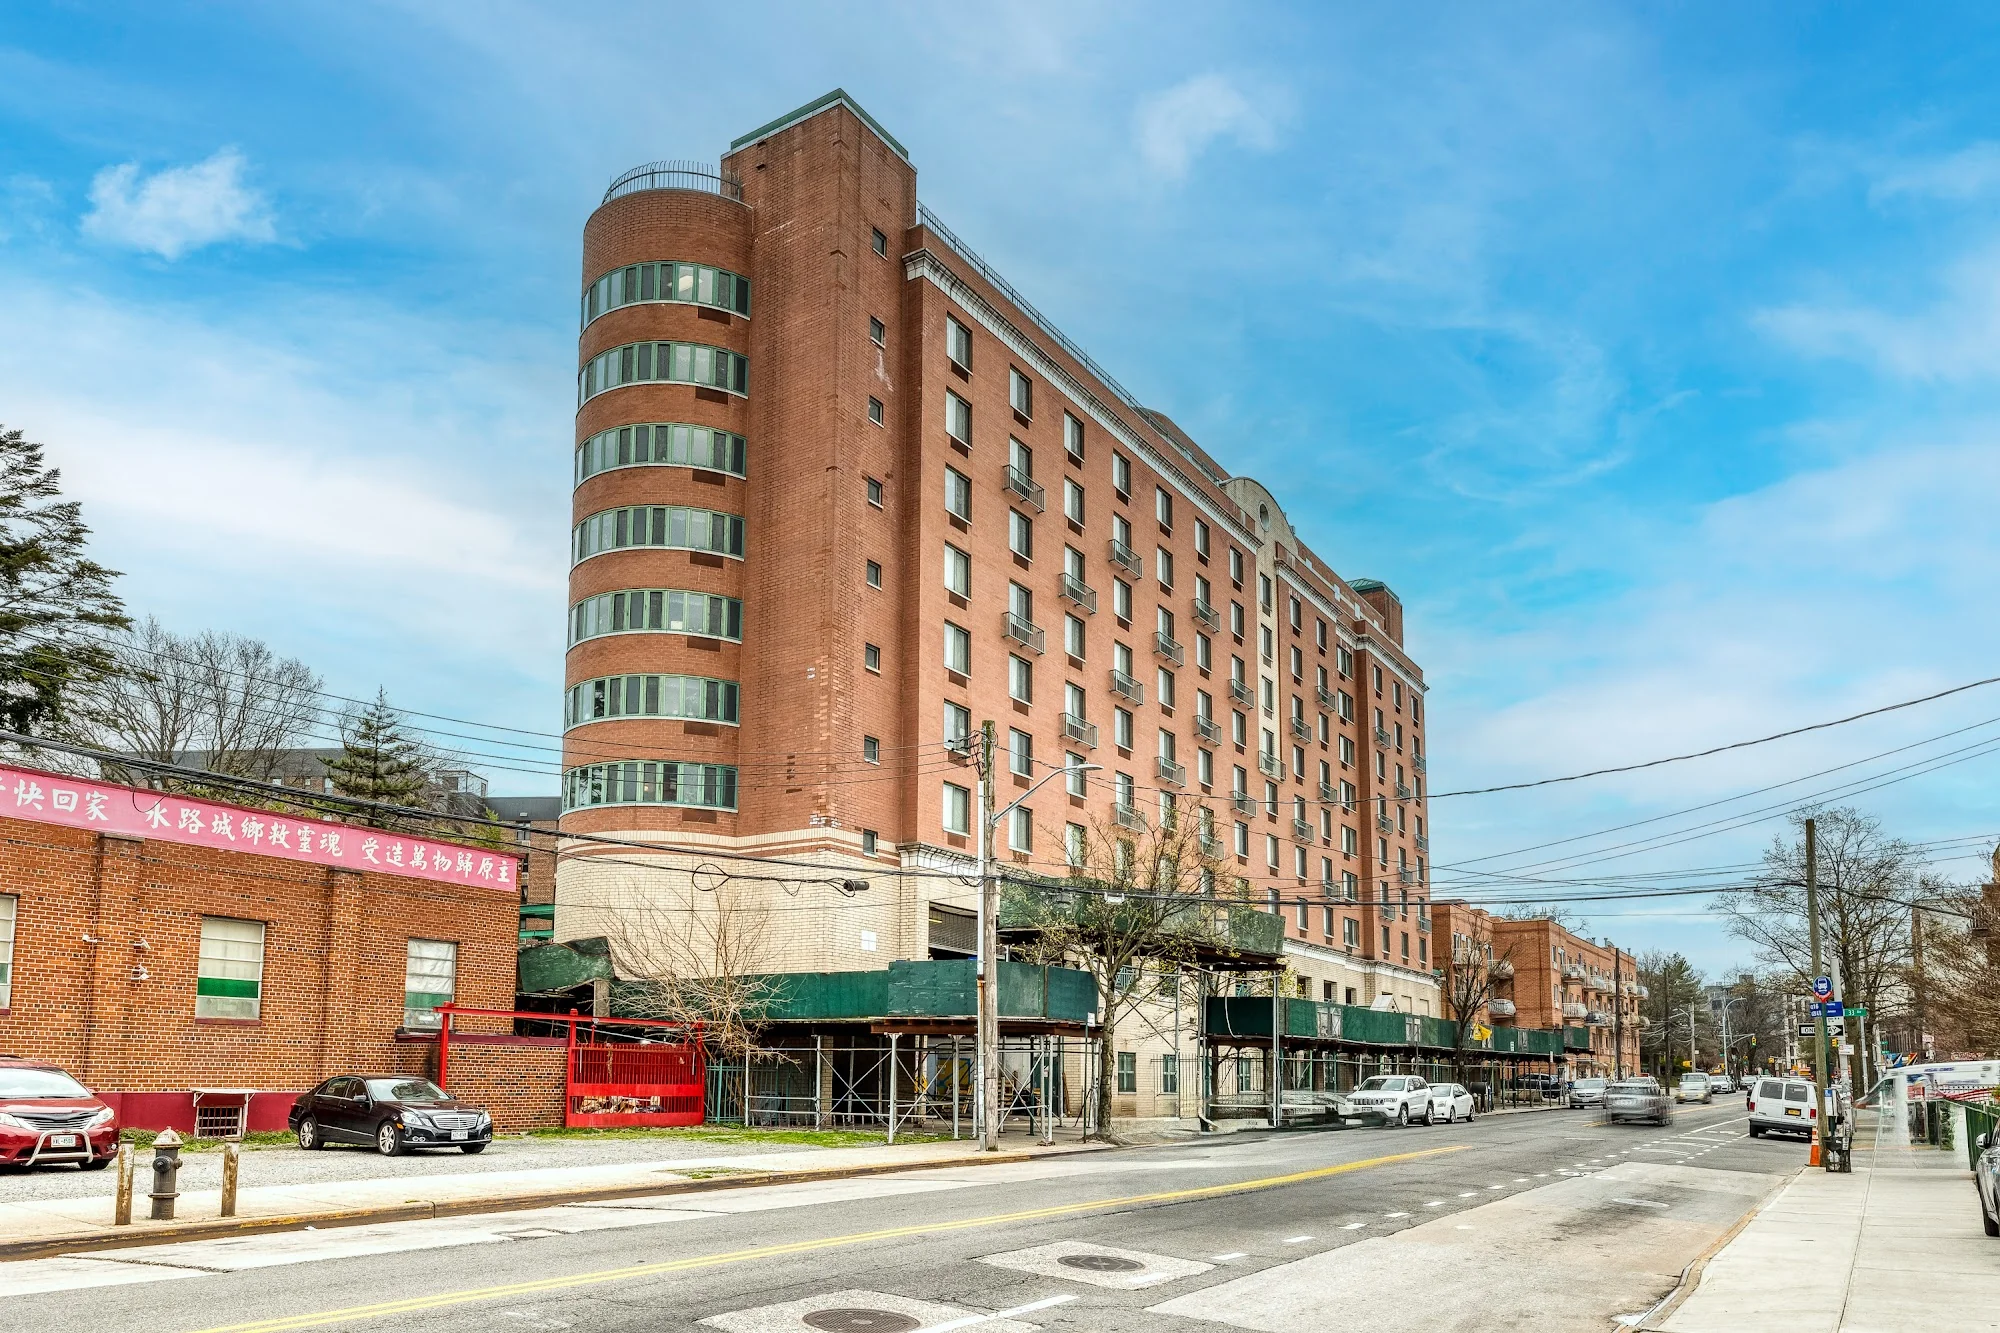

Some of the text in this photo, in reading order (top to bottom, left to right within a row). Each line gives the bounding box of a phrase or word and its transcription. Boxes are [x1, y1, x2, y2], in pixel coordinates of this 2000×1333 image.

[0, 774, 110, 821] 快回家
[361, 836, 512, 883] 受造萬物歸原主
